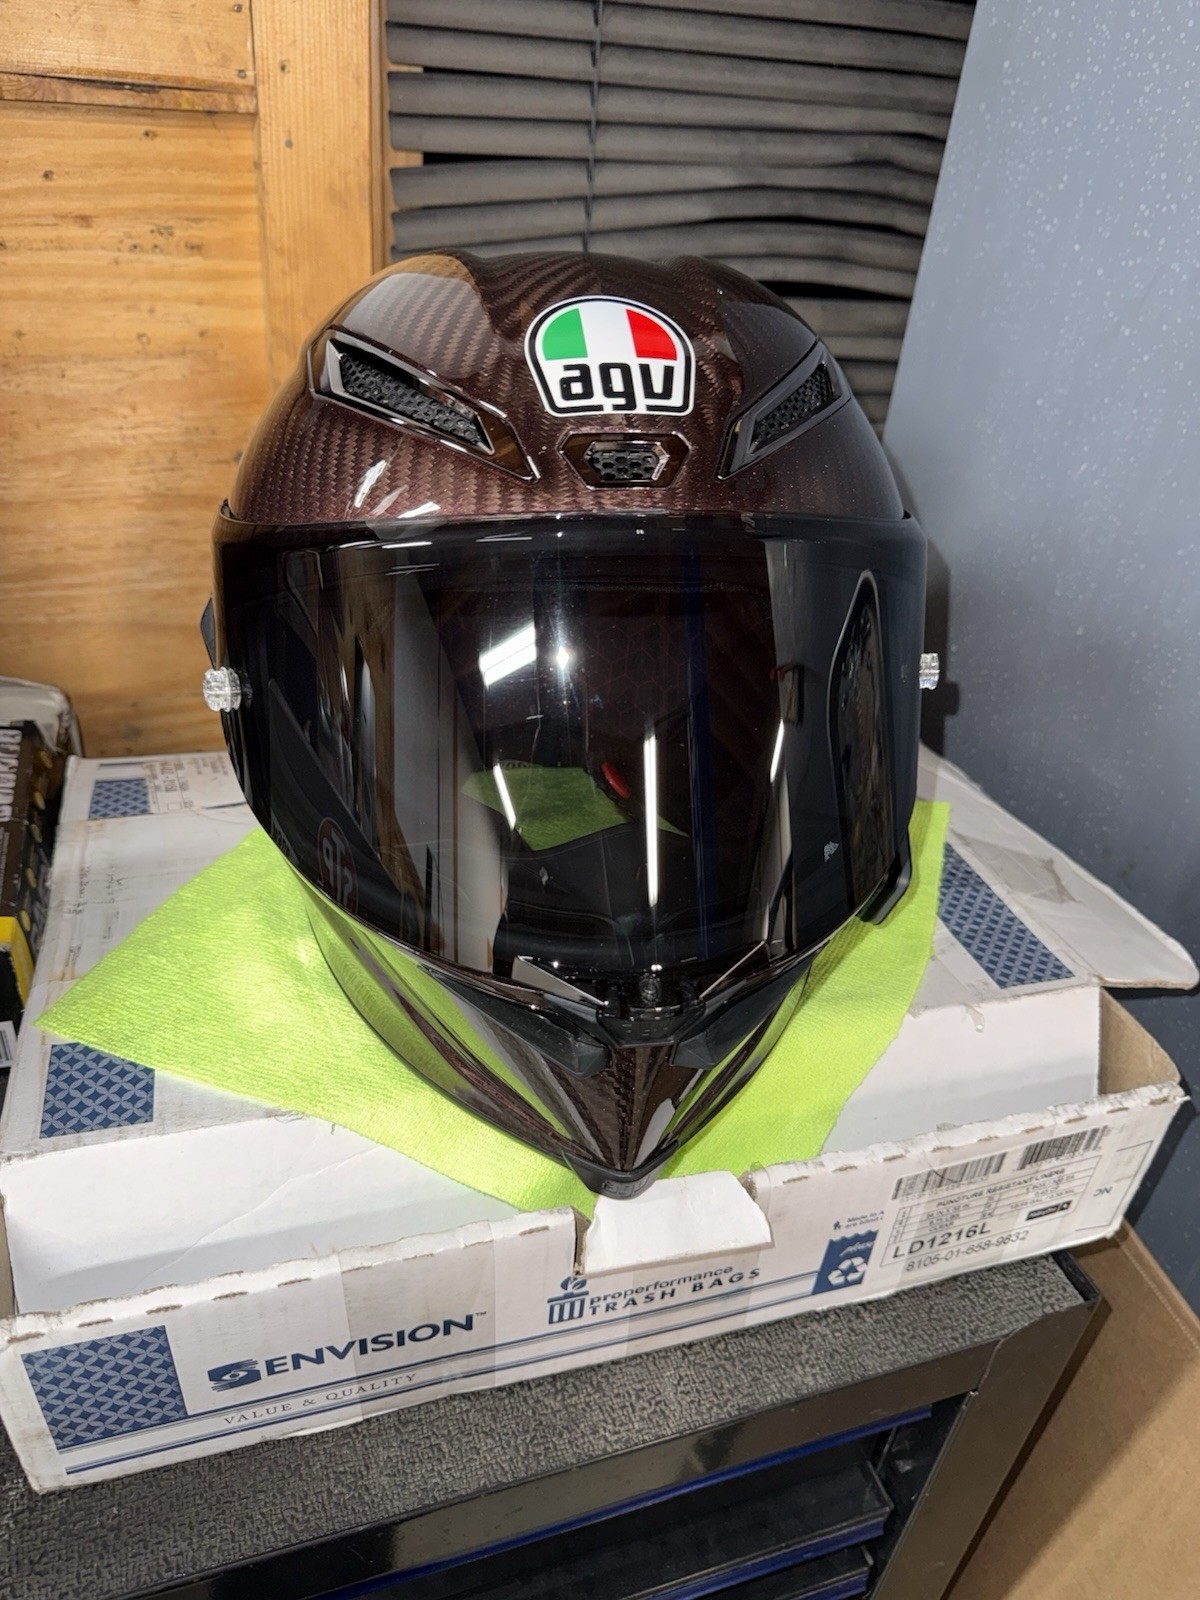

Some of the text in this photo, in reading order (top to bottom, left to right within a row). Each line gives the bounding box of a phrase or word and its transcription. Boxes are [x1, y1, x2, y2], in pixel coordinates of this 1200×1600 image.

[559, 362, 675, 411] agv
[892, 1222, 992, 1259] LD1216L
[589, 1265, 734, 1305] properformance
[589, 1267, 761, 1315] TRASH BAGS
[265, 1313, 475, 1377] ENVISION
[224, 1373, 417, 1425] VALUE & QUALITY
